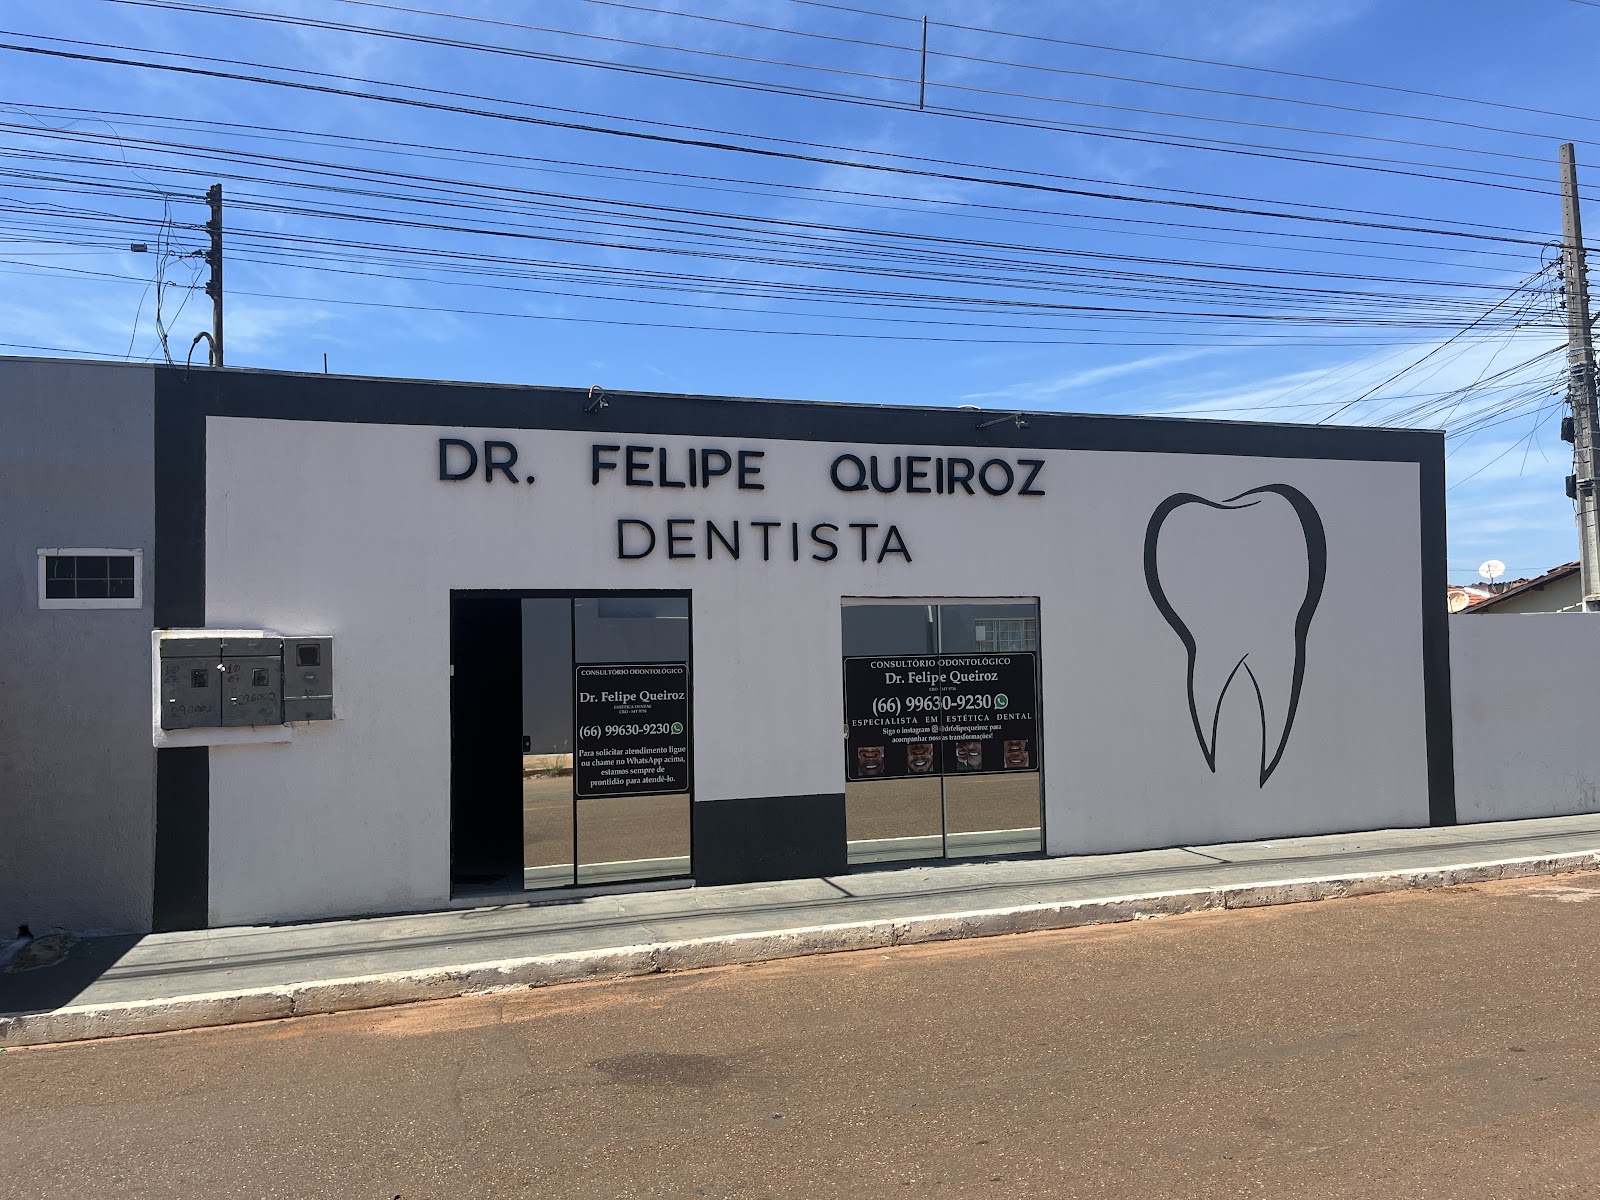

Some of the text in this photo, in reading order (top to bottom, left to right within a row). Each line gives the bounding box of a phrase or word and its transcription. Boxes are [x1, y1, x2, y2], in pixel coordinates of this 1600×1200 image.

[437, 438, 1046, 497] DR. FELIPE QUEIROZ
[617, 518, 913, 564] DENTISTA
[870, 657, 1011, 669] CONSULTÓRIO ODONTOLÓGICO
[581, 667, 683, 676] CONSULTÓRIO ODONTOLÓGICO
[885, 670, 998, 686] Dr. Felipe Queiroz
[579, 690, 685, 704] Dr. Felipe Queiroz
[872, 694, 992, 717] (66) 99630-9230
[852, 717, 918, 727] ESPECIALISTA
[946, 714, 989, 723] ESTÉTICA
[997, 713, 1032, 721] DENTAL
[579, 723, 670, 740] (66) 99630-9230
[882, 728, 895, 737] Siga
[901, 726, 930, 736] instagram
[989, 724, 1002, 732] para
[891, 734, 927, 745] acompanhar
[949, 732, 993, 743] transformações!
[579, 746, 686, 757] Para solicitar atendimento ligue
[591, 758, 615, 767] chame
[626, 757, 663, 767] WhatsApp
[663, 756, 686, 764] acima,
[600, 768, 629, 776] estamos
[629, 767, 655, 777] sempre
[590, 777, 625, 788] prontidão
[625, 777, 641, 786] para
